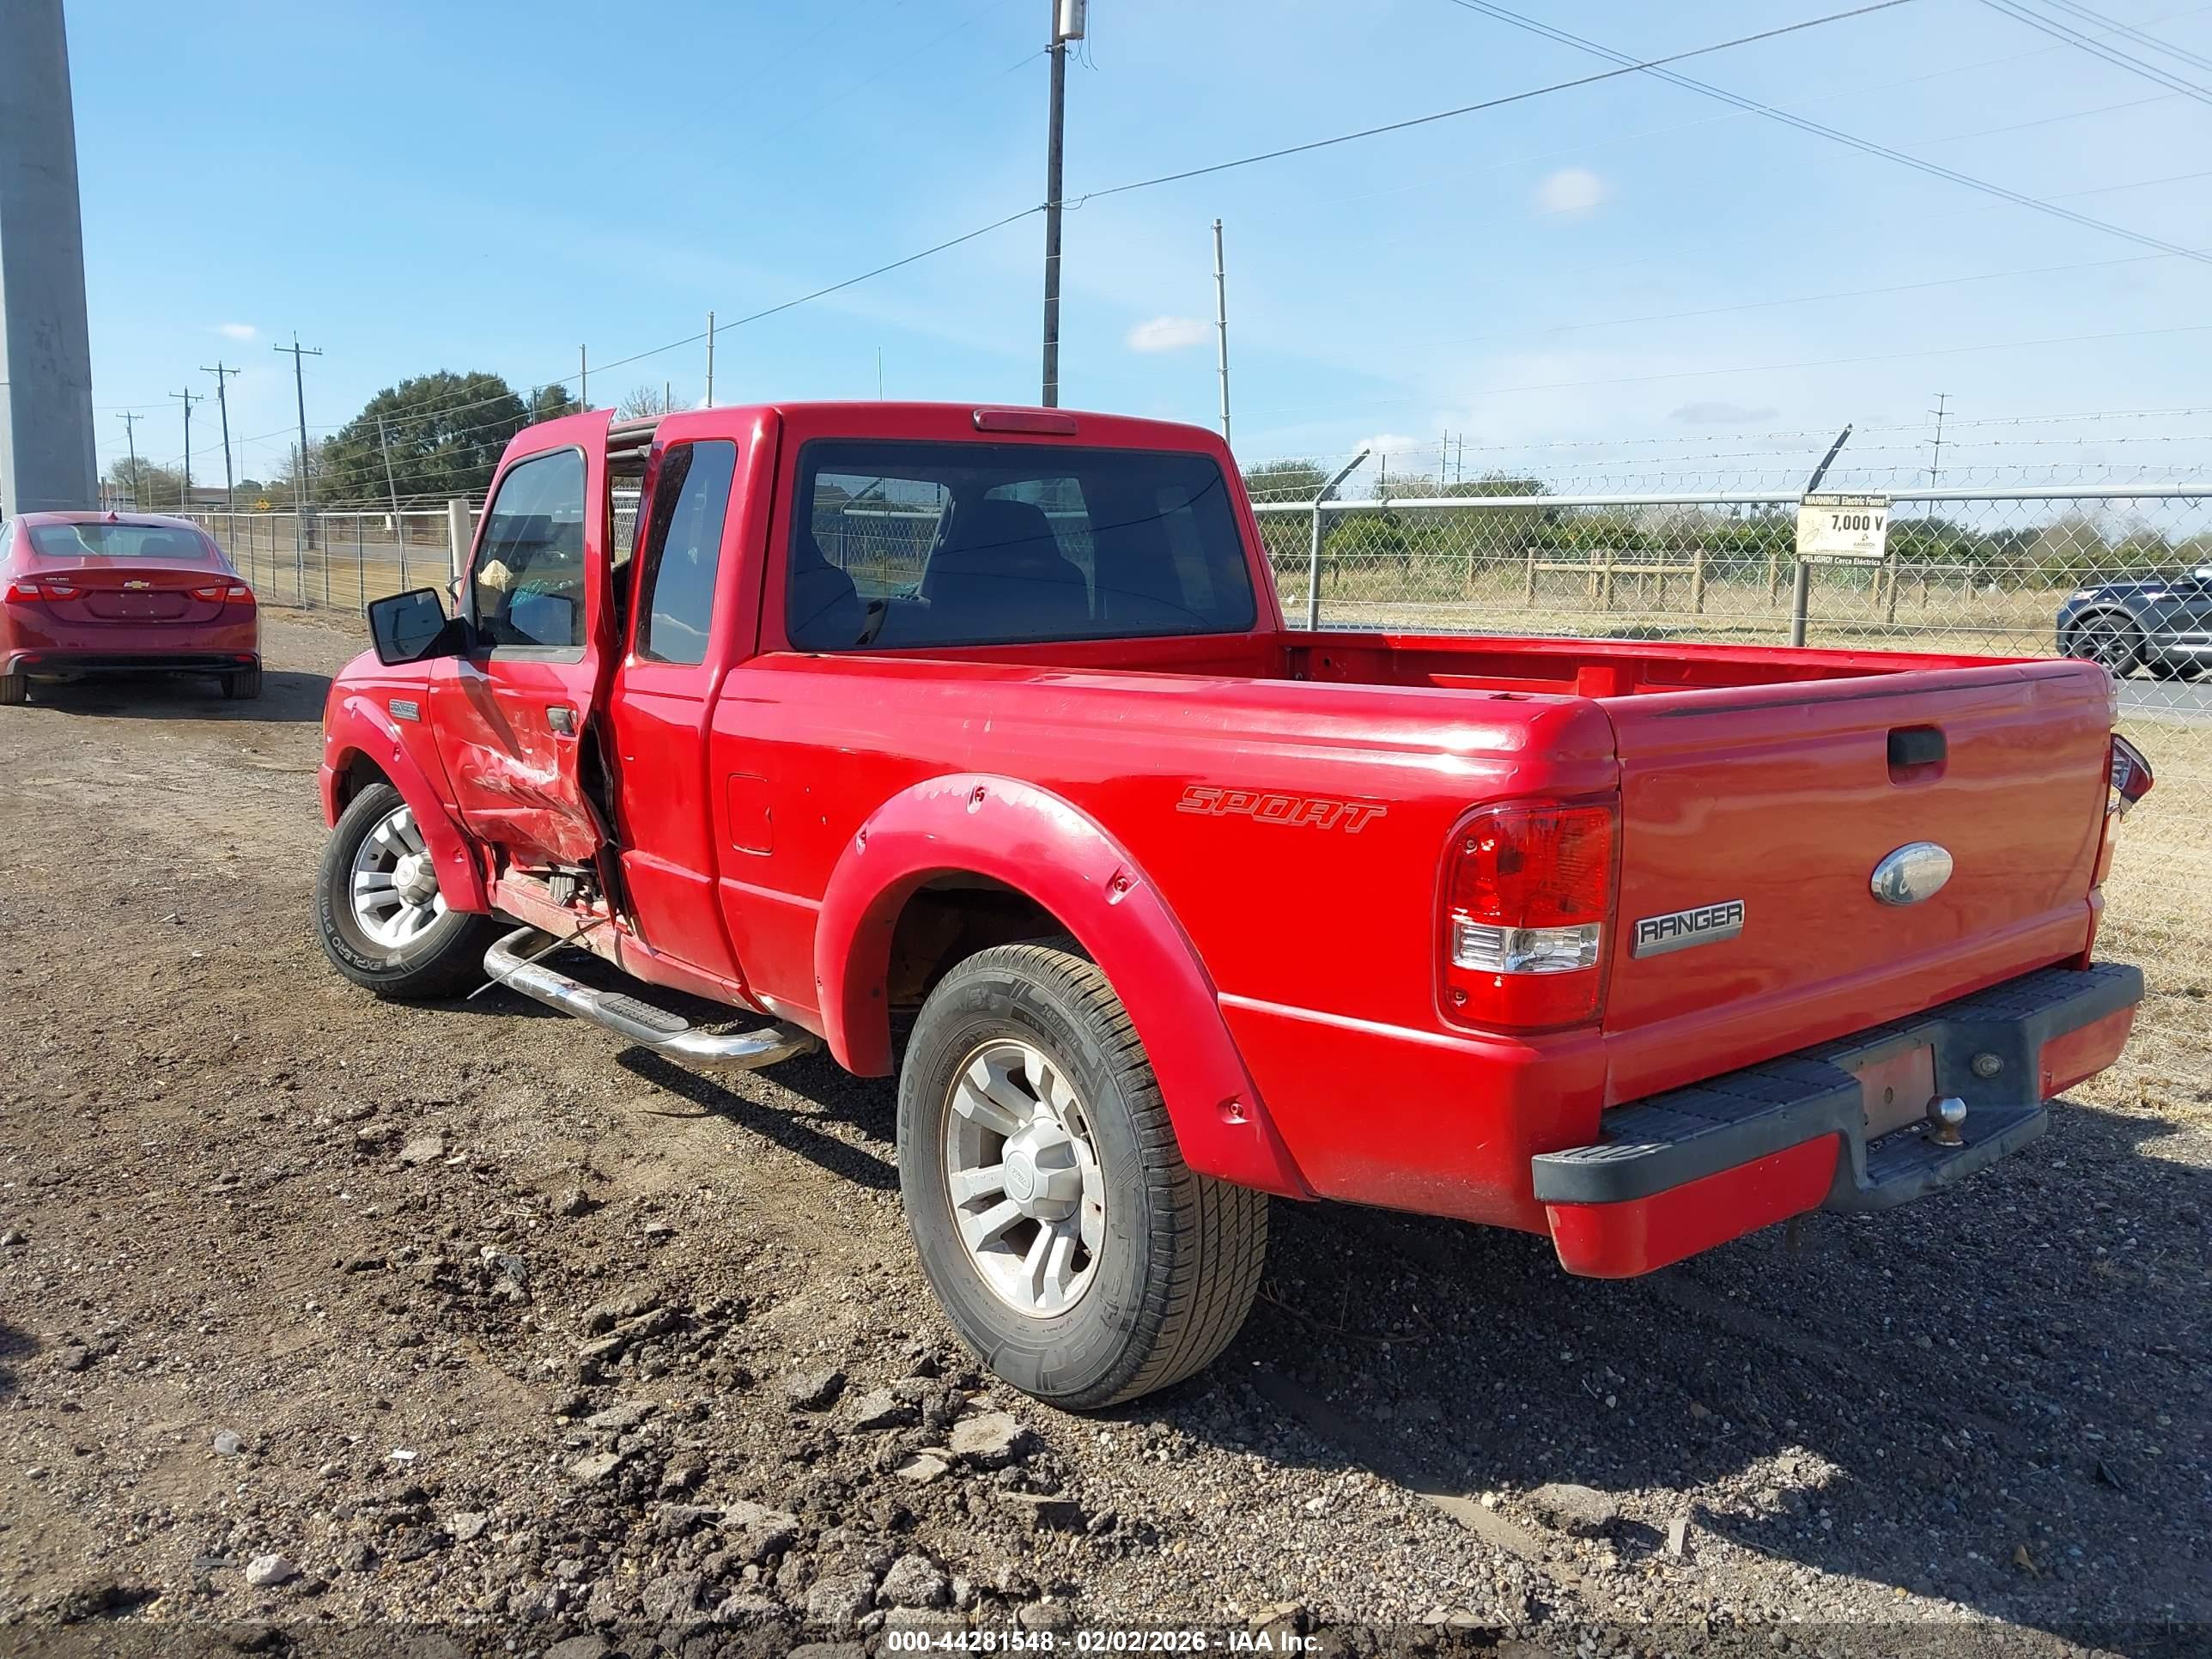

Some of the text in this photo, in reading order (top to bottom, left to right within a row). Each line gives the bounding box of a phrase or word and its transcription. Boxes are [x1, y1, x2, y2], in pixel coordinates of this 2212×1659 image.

[1805, 495, 1886, 507] WARNING! Electric Fence
[1832, 514, 1884, 532] 7,000 V
[1800, 555, 1881, 566] ¡PELIGRO! Cerca Eléctrica
[1176, 786, 1388, 833] SPORT
[1640, 902, 1742, 944] RANGER
[331, 935, 382, 971] EXPLERO
